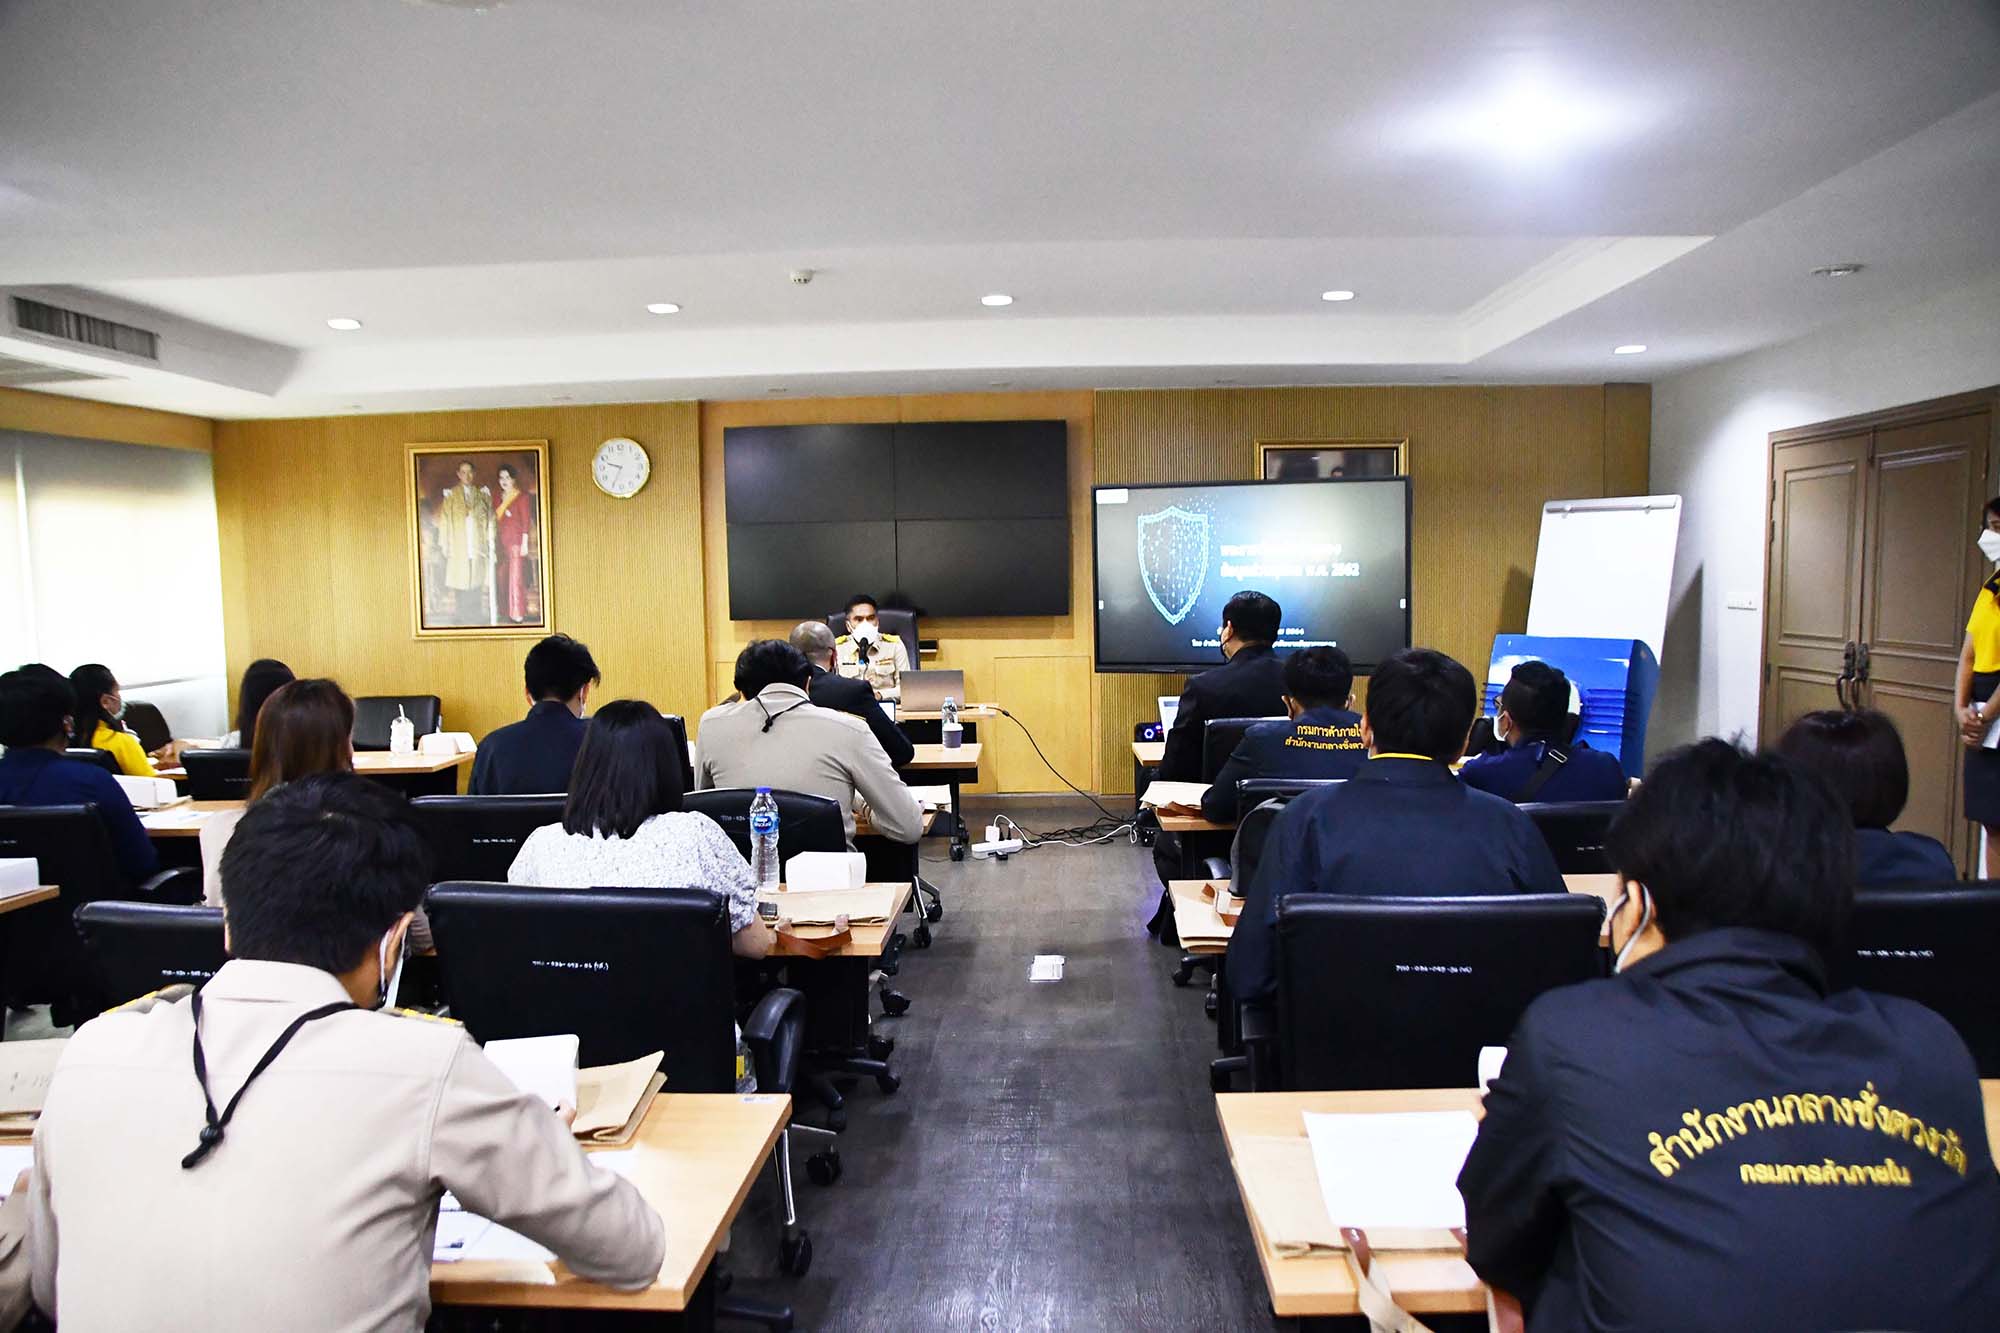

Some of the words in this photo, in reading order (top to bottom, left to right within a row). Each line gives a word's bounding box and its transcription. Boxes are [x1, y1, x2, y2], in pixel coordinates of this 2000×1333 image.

[1648, 1081, 1967, 1178] สำนักงานกลางชั่งตวงวัด
[1739, 1157, 1913, 1187] กรมการค้าภายใน
